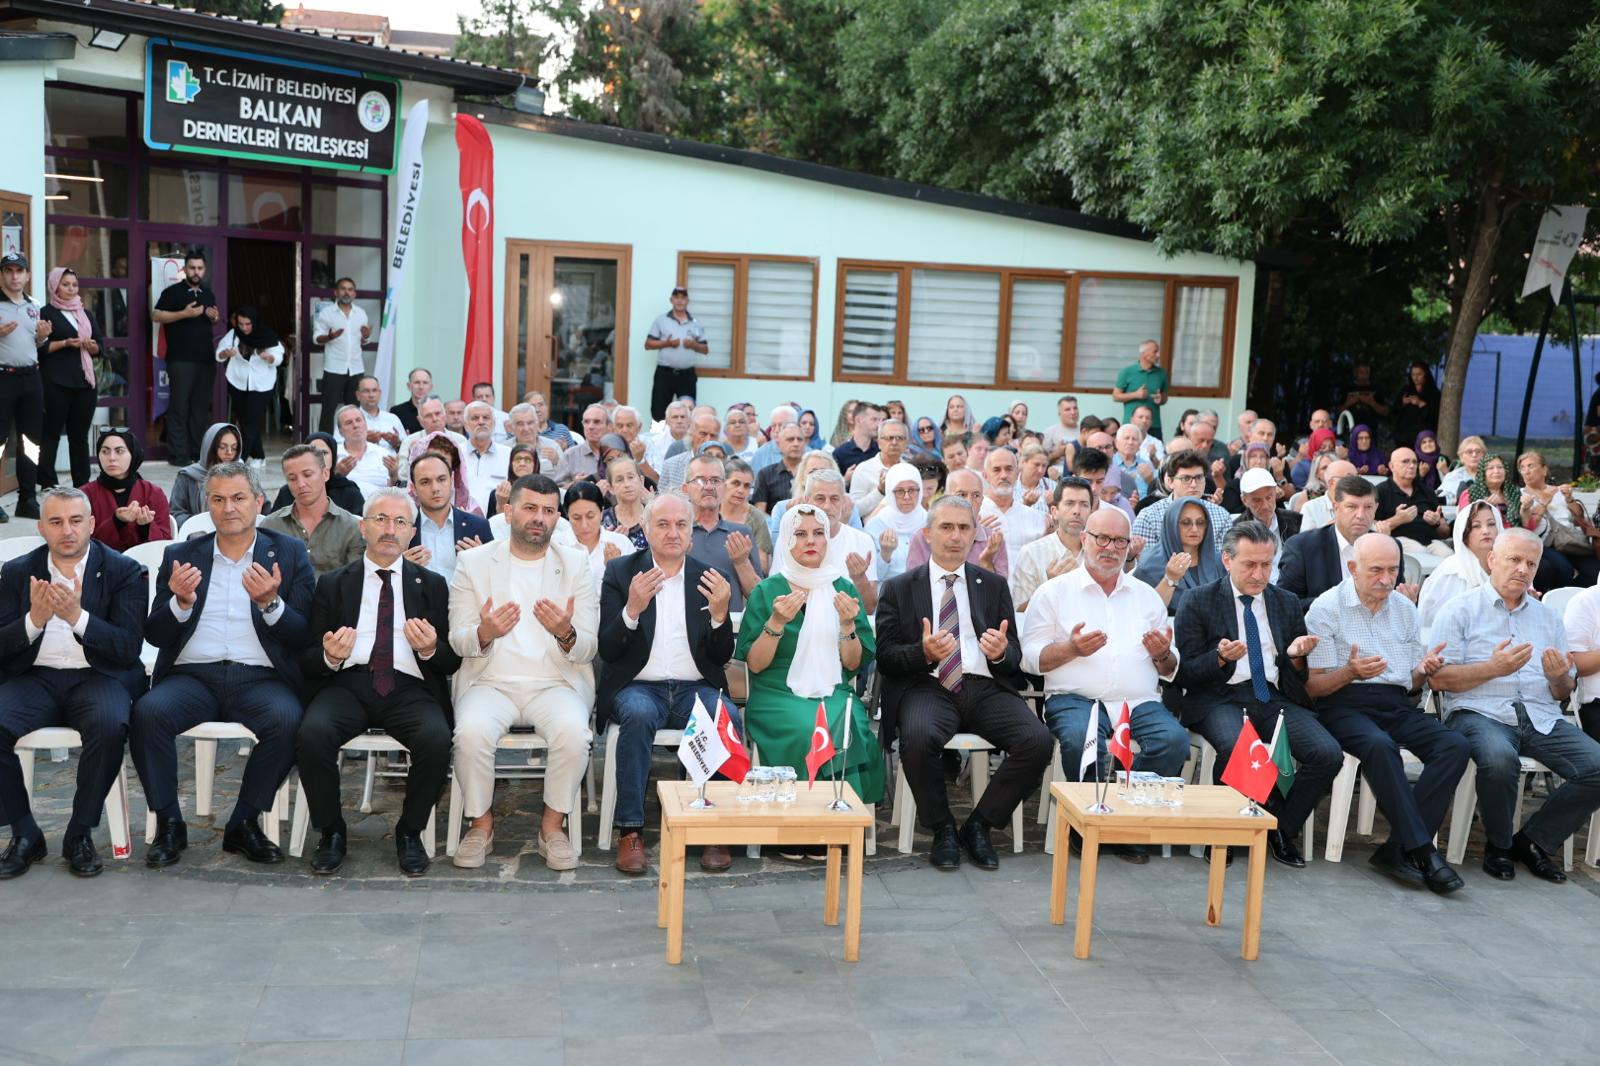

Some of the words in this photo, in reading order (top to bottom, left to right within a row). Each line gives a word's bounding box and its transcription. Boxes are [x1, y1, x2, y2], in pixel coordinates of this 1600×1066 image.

[204, 66, 231, 87] T.C.
[232, 68, 275, 92] İZMİT
[276, 78, 357, 105] BELEDİYESİ
[239, 96, 322, 129] BALKAN
[183, 118, 280, 149] DERNEKLERİ
[284, 131, 369, 160] YERLEŞKESİ
[392, 162, 422, 270] BELEDİYESİ
[688, 740, 710, 775] BELEDİYESİ
[694, 735, 706, 753] İZMİT
